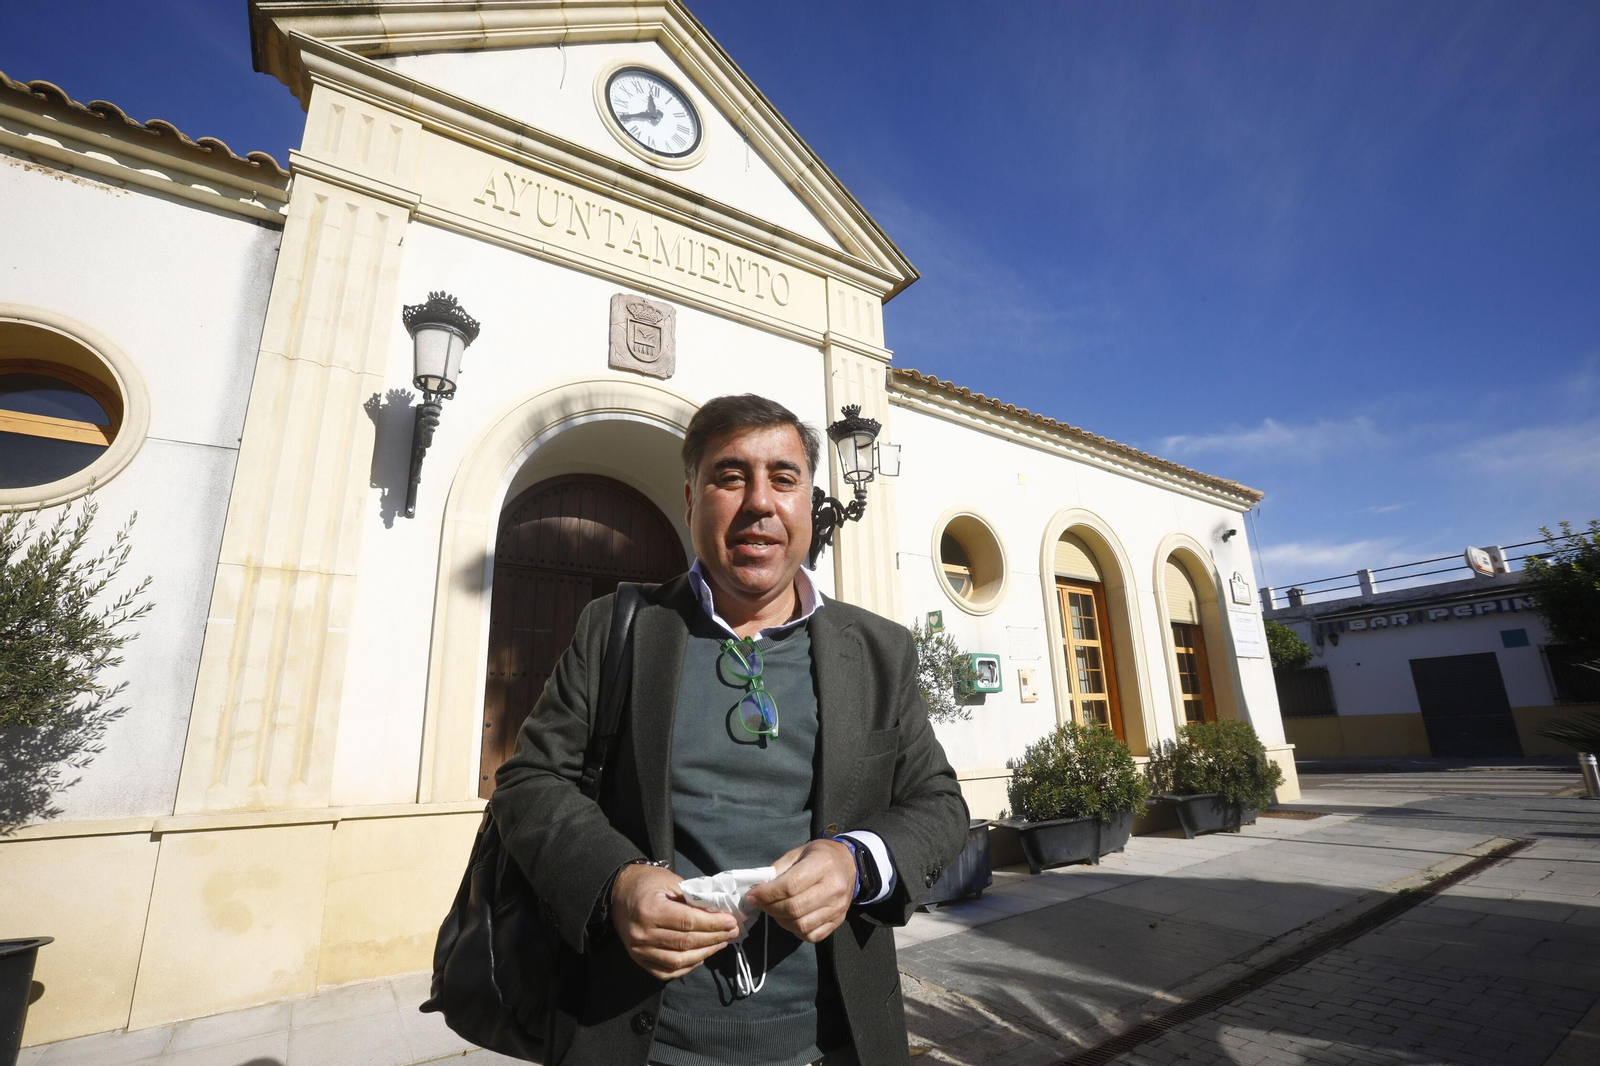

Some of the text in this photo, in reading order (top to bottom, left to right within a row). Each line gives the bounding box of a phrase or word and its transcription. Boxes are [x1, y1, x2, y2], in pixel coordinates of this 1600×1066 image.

[619, 85, 633, 98] X
[473, 168, 791, 306] AYUNTAMIENTO
[1348, 613, 1409, 631] BAR
